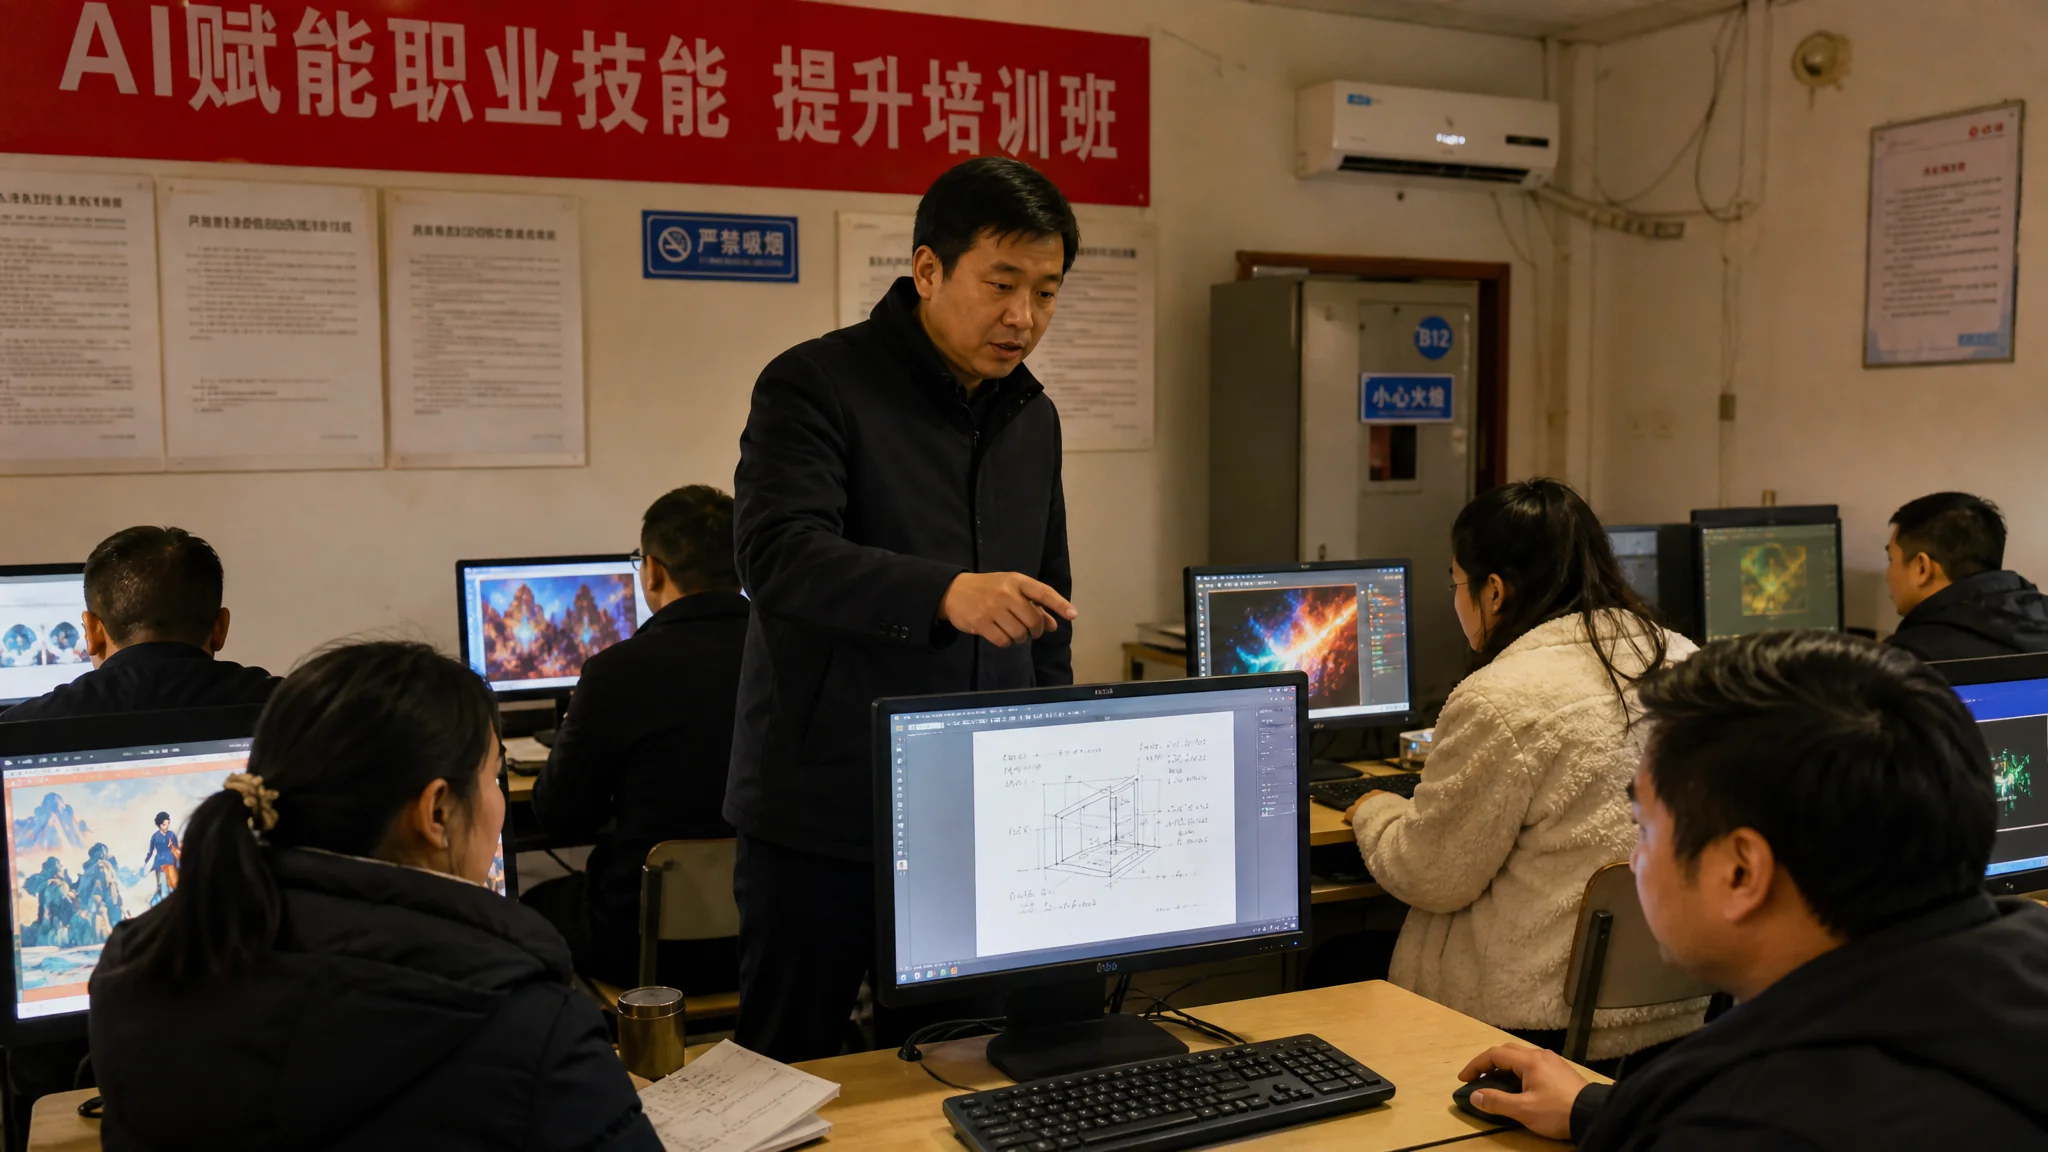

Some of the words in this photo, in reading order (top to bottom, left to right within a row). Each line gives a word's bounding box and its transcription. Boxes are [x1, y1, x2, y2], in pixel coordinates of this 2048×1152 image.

[58, 1, 731, 138] AI赋能职业技能
[772, 44, 1118, 162] 提升培训班
[697, 228, 785, 256] 严禁吸烟
[1418, 328, 1450, 348] B12
